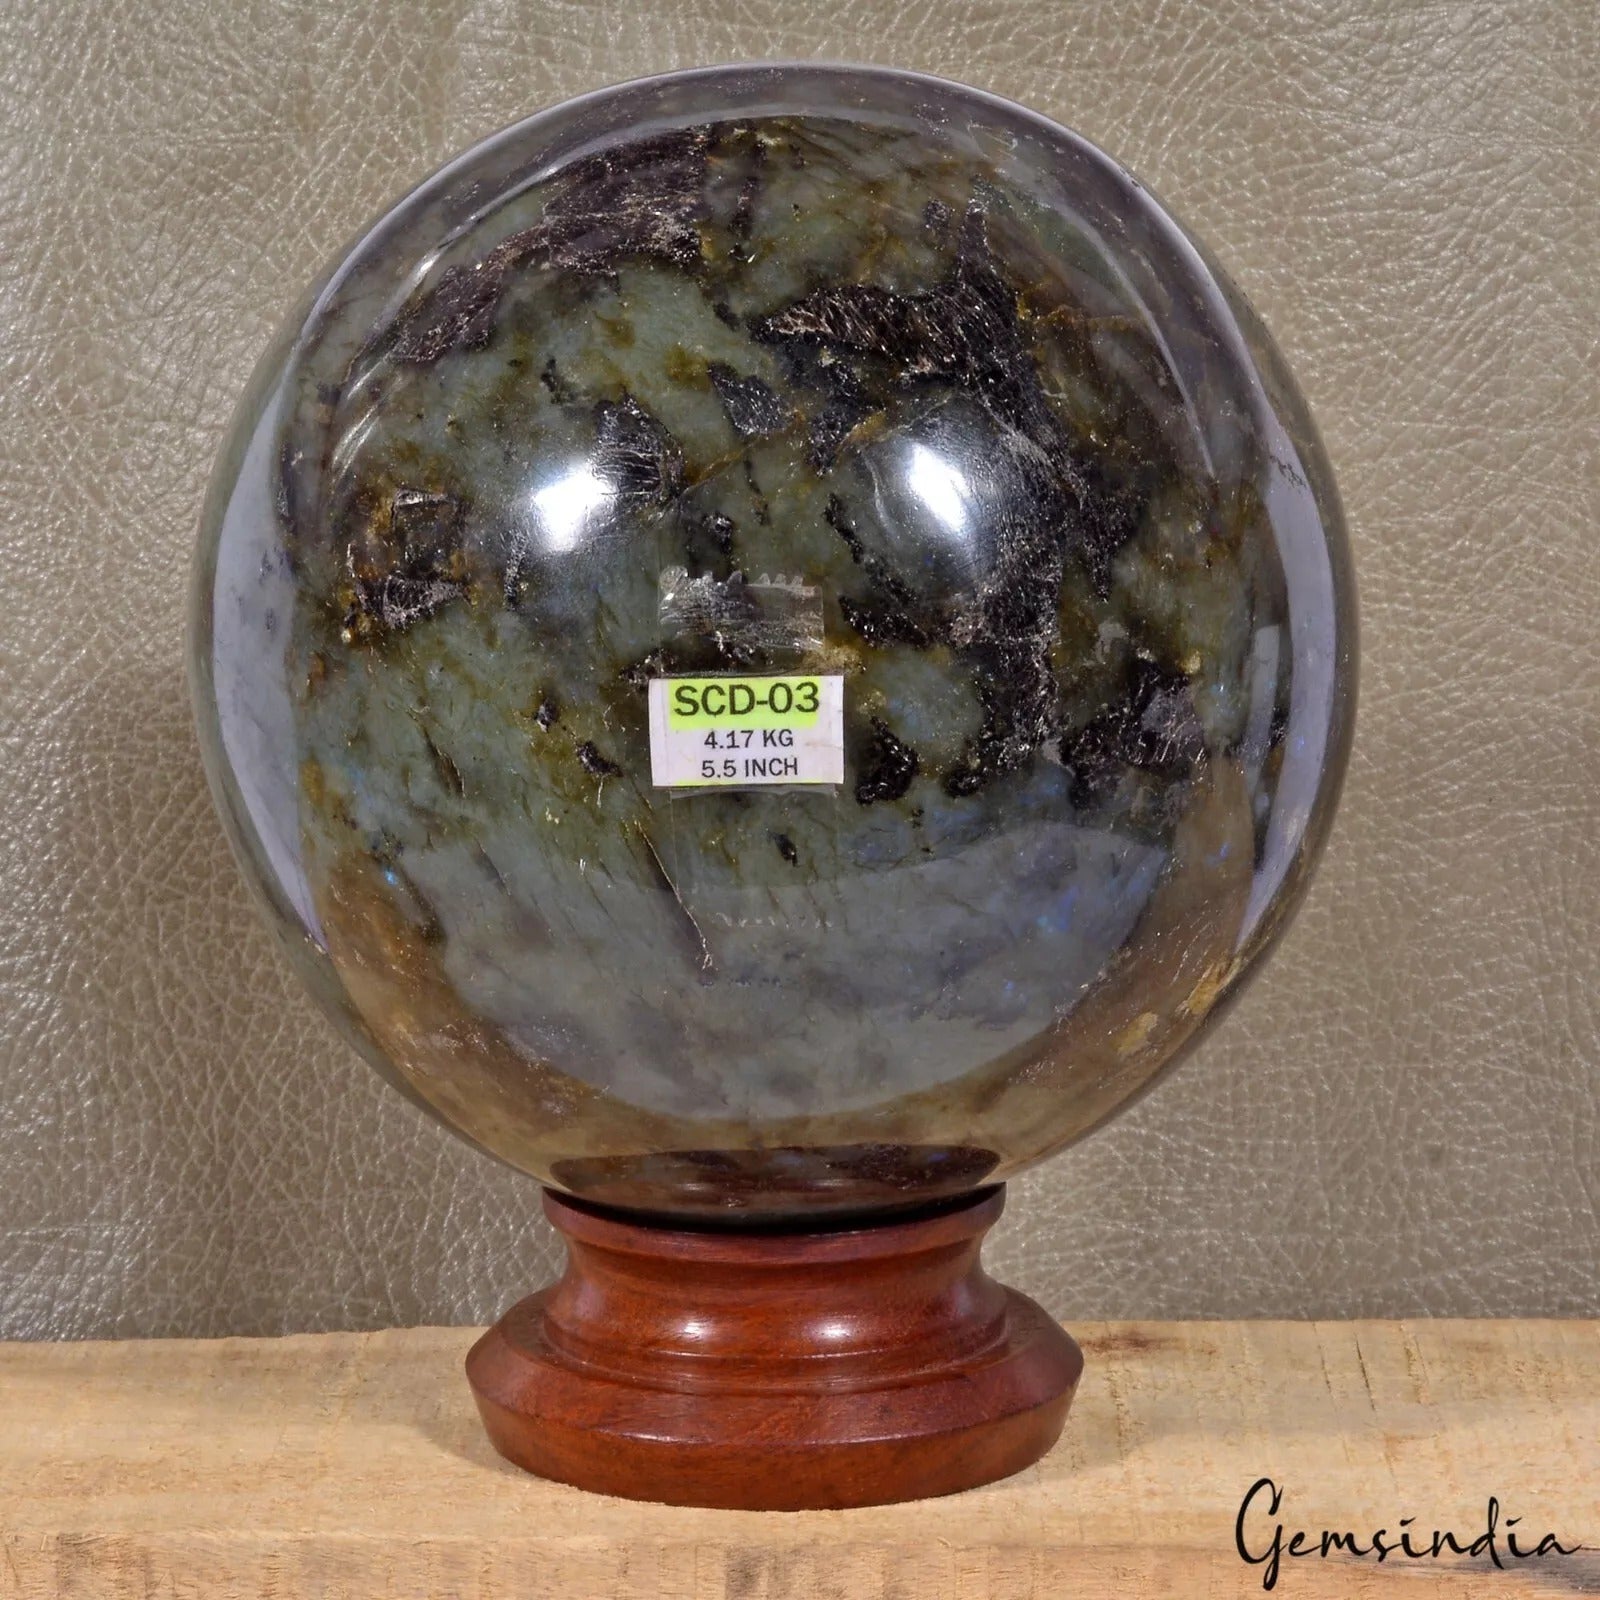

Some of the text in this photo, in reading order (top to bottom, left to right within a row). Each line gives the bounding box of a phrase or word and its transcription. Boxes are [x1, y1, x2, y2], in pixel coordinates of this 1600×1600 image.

[674, 682, 820, 717] SCD-03
[703, 728, 794, 750] 4.17 KG
[701, 757, 798, 779] 5.5 INCH
